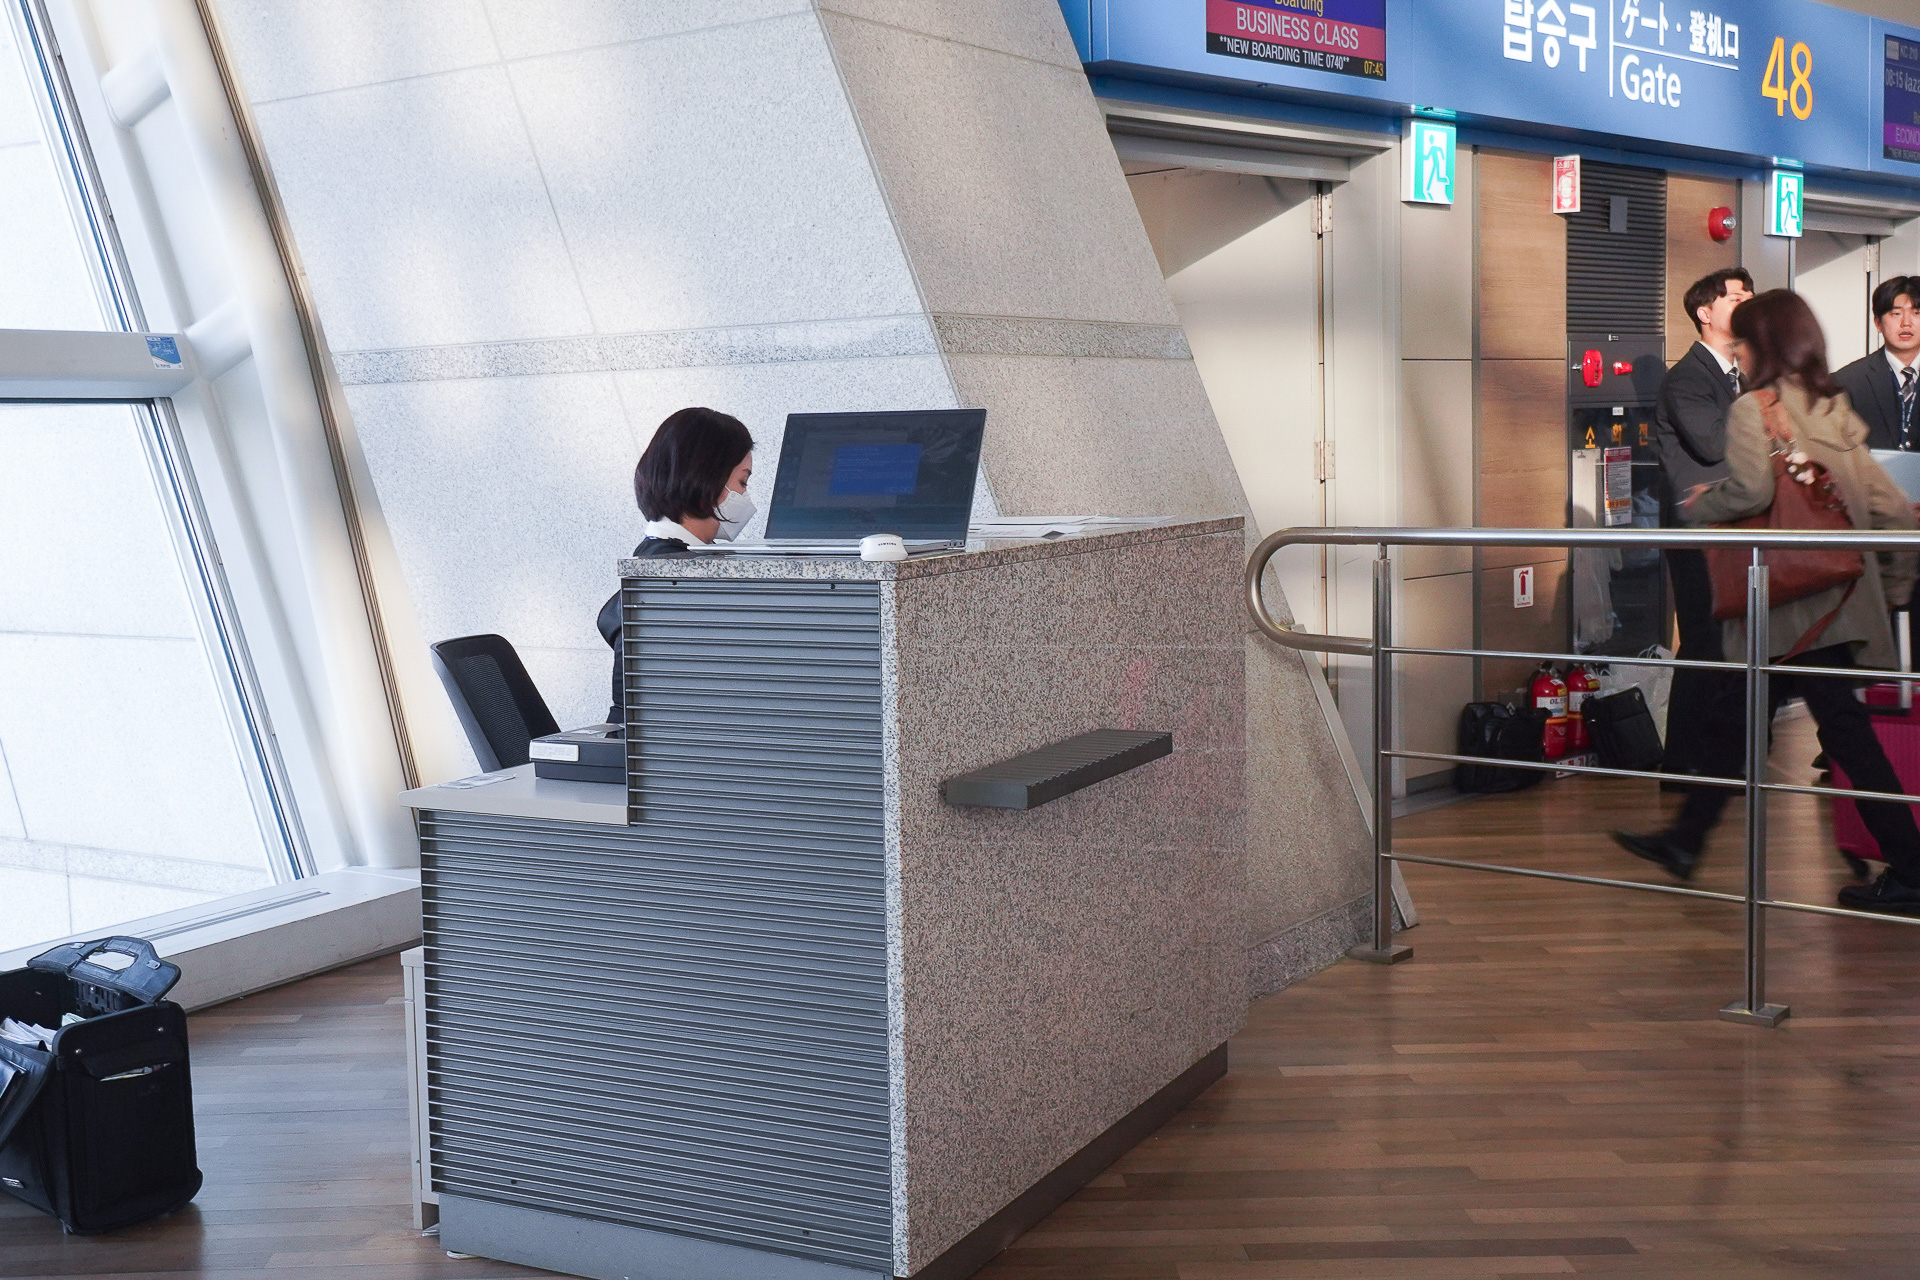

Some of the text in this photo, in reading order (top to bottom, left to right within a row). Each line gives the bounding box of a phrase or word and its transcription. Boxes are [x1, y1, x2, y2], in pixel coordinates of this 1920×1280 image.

[1236, 7, 1359, 50] BUSINESS CLASS
[1503, 0, 1597, 72] 탑승구
[1251, 41, 1300, 63] BOARDING
[1302, 50, 1323, 67] TIME
[1363, 60, 1384, 76] 07:43
[1621, 54, 1681, 108] Gate
[1761, 37, 1813, 120] 48
